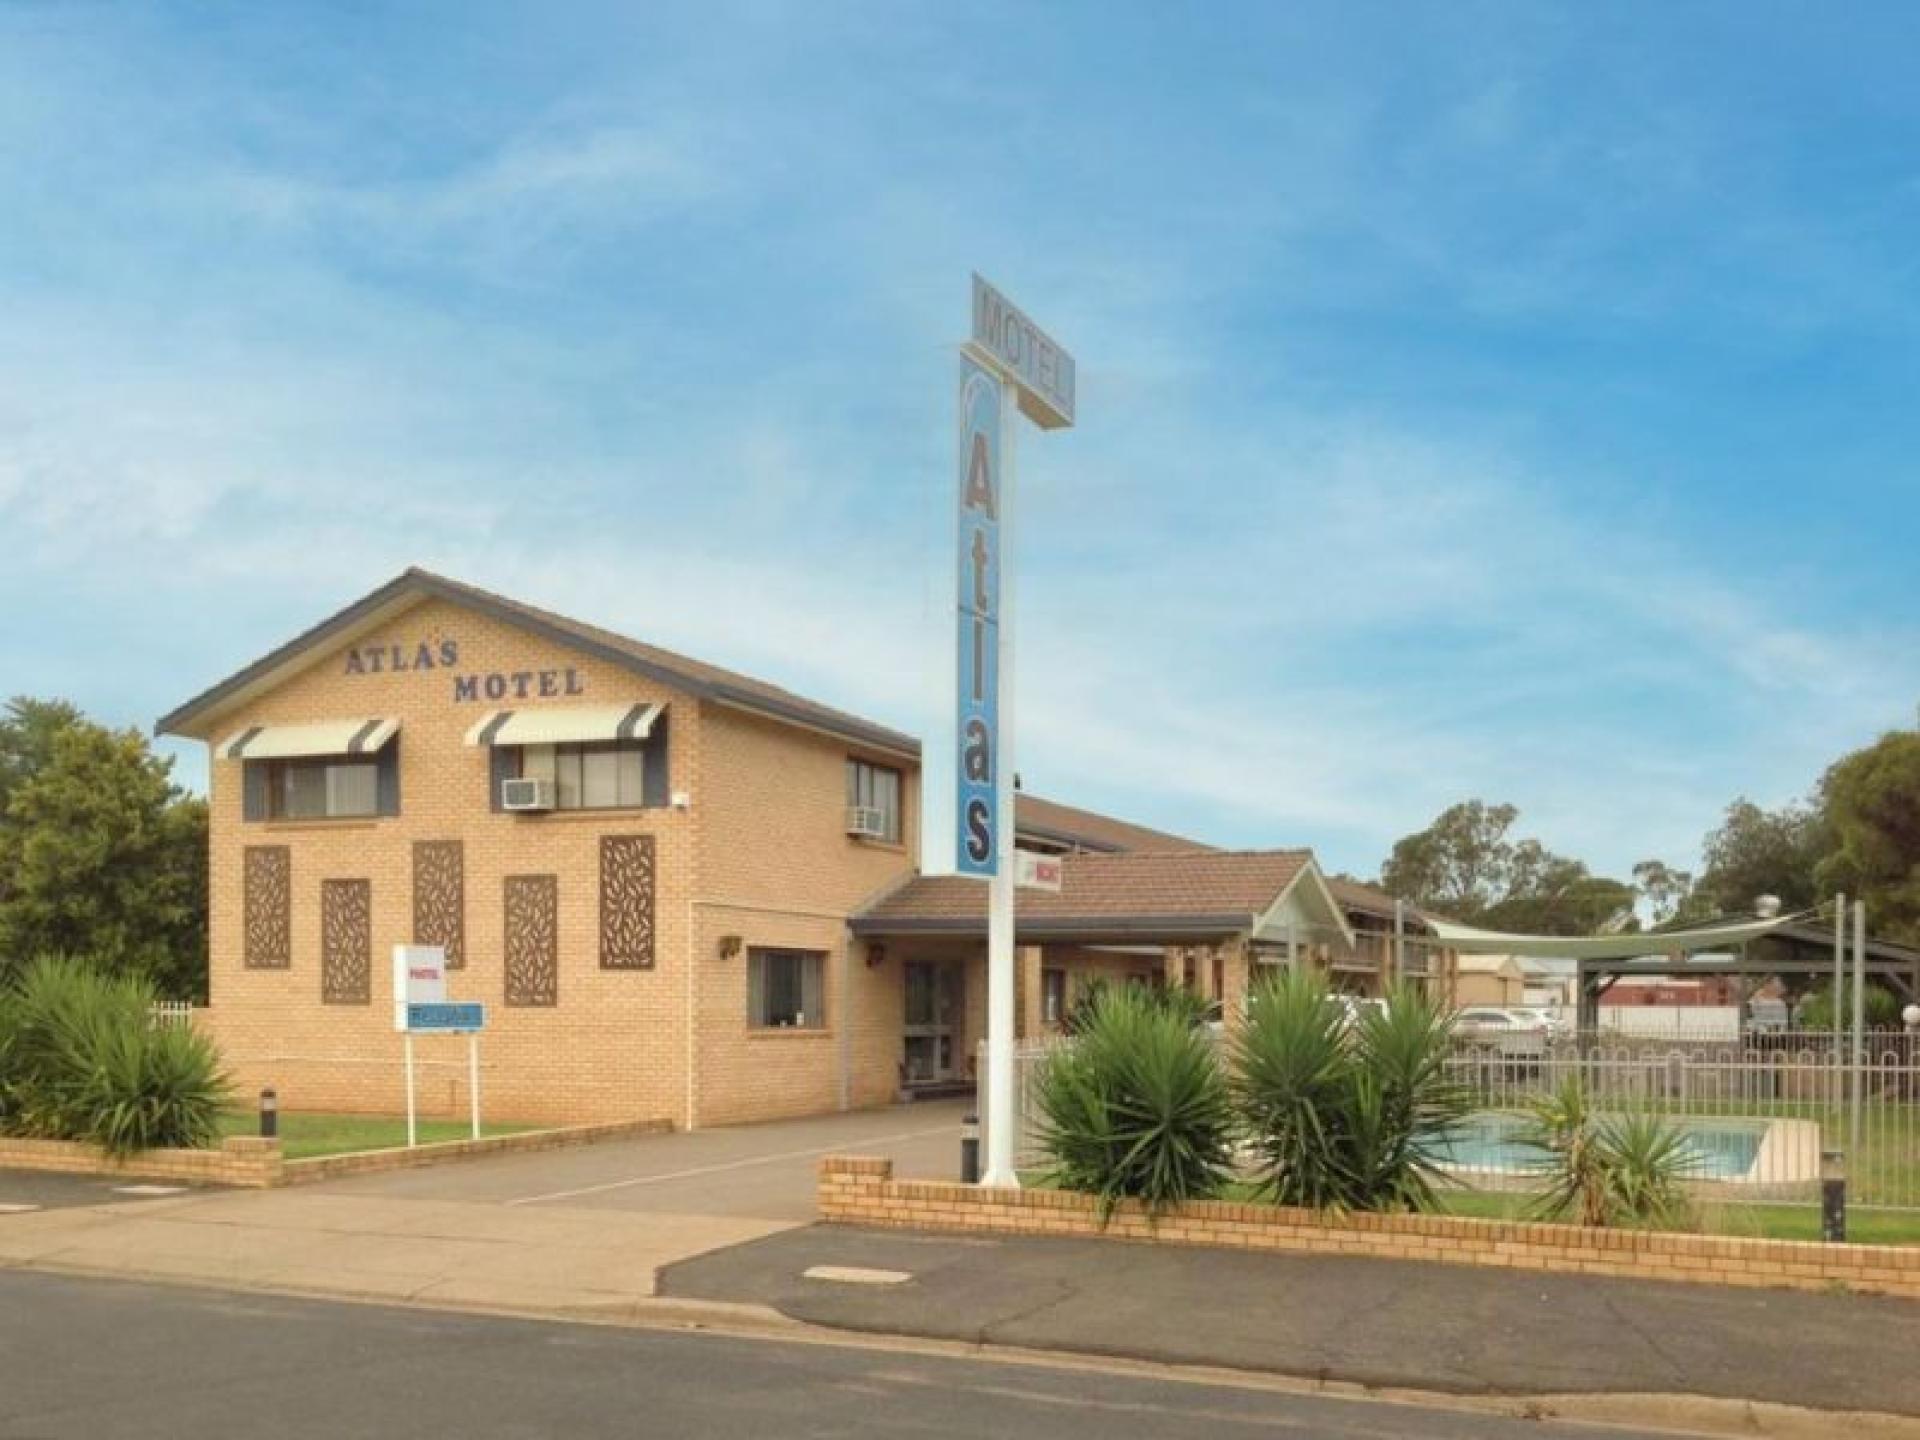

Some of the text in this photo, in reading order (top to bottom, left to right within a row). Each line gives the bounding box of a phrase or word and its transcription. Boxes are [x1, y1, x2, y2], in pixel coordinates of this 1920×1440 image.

[982, 285, 1067, 411] MOTEL
[454, 669, 584, 702] MOTEL
[964, 431, 996, 864] Atlas
